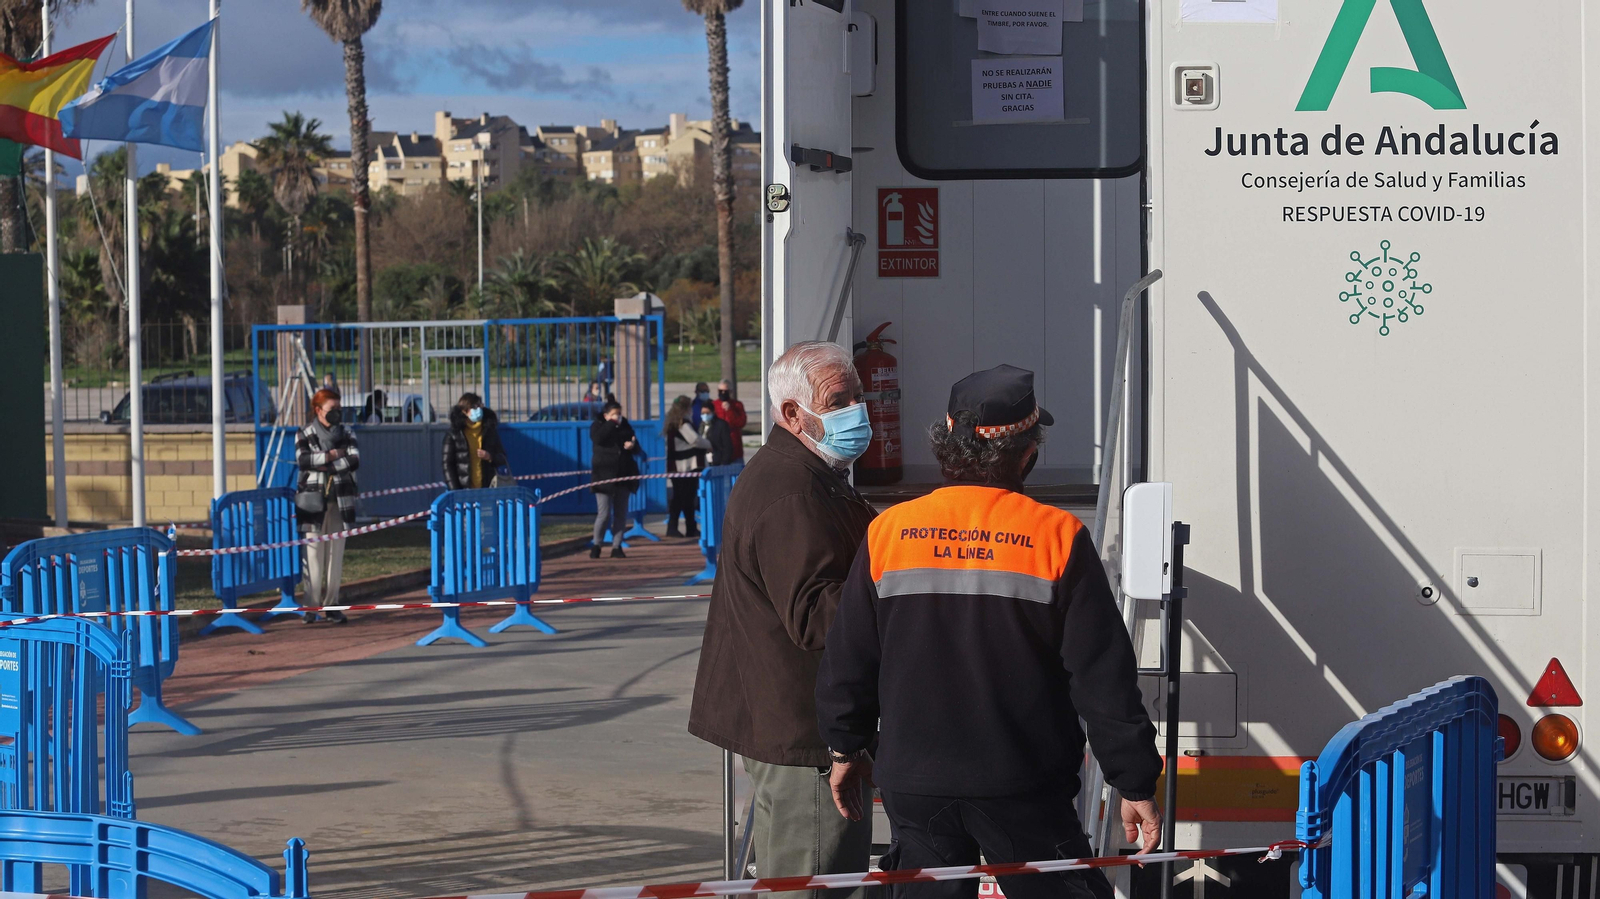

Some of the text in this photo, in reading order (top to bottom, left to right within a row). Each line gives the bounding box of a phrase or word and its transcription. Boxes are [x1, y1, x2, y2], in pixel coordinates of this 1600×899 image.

[982, 9, 999, 17] ENTRE
[987, 20, 1011, 28] TIMBRE,
[982, 69, 994, 77] NO
[1005, 66, 1052, 76] REALIZARÁN
[982, 81, 1017, 89] PRUEBAS
[1025, 79, 1052, 89] NADIE
[1001, 104, 1035, 112] GRACIAS
[1204, 119, 1559, 157] Junta de Andalucía
[1241, 169, 1526, 193] Consejería de Salud y Familias
[1282, 205, 1486, 222] RESPUESTA COVID-19
[880, 258, 937, 270] EXTINTOR
[900, 527, 1034, 548] PROTECCIÓN CIVIL
[934, 544, 995, 560] LA LÍNEA
[0, 659, 19, 672] PORTES
[1498, 782, 1550, 810] HGW
